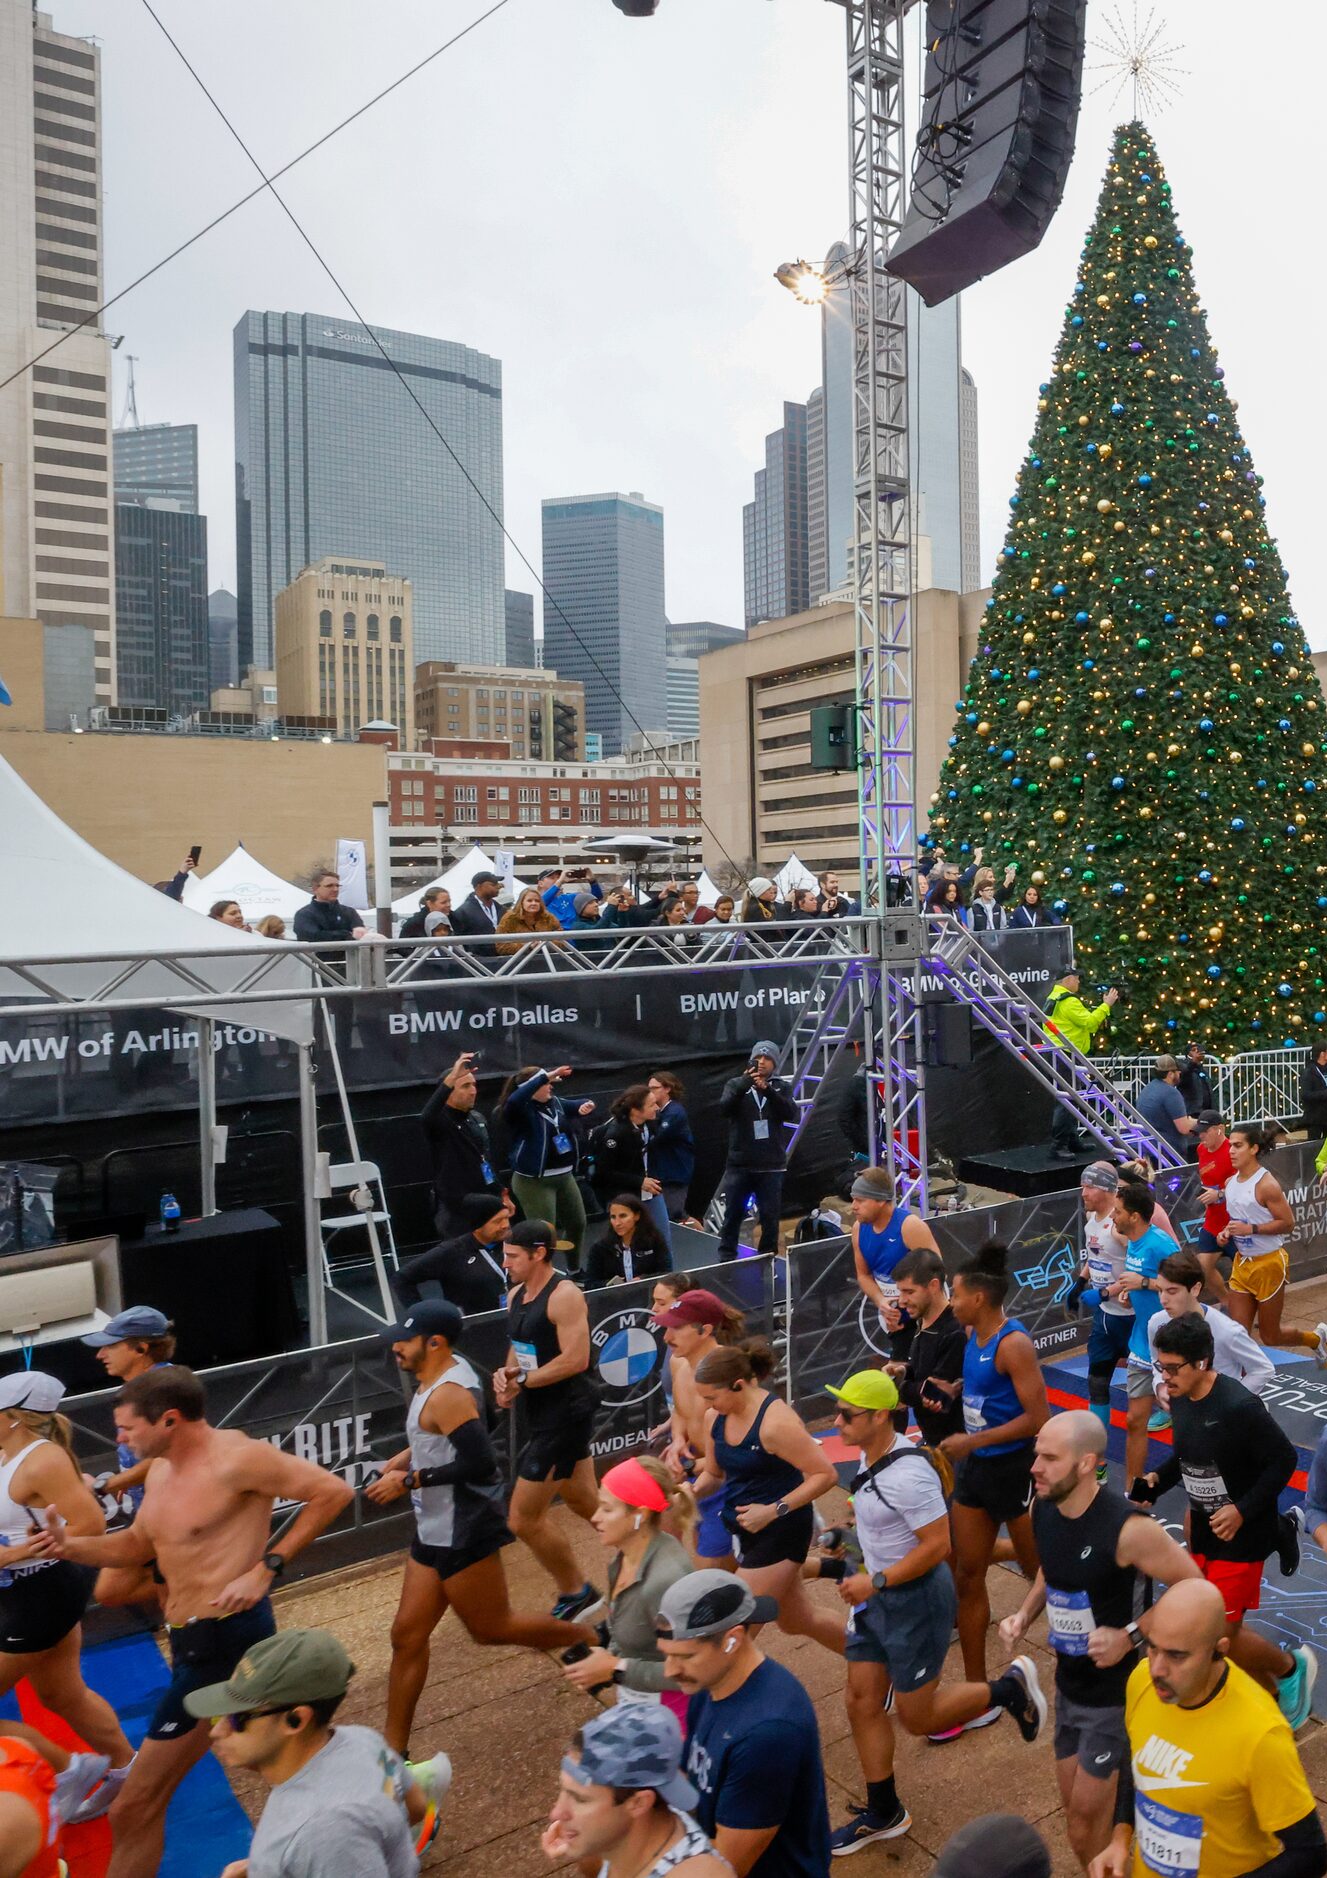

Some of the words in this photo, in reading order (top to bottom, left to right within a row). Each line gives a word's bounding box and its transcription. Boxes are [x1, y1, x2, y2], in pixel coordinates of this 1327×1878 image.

[336, 330, 393, 349] Santander
[680, 991, 740, 1013] BMW
[744, 989, 767, 1009] of
[772, 987, 826, 1006] Plano
[389, 1009, 463, 1034] BMW
[468, 1007, 497, 1029] of
[501, 1004, 579, 1027] Dallas
[0, 1035, 70, 1064] MW
[77, 1031, 115, 1058] of
[121, 1025, 277, 1054] Arlinton
[1137, 1734, 1195, 1781] NIKE
